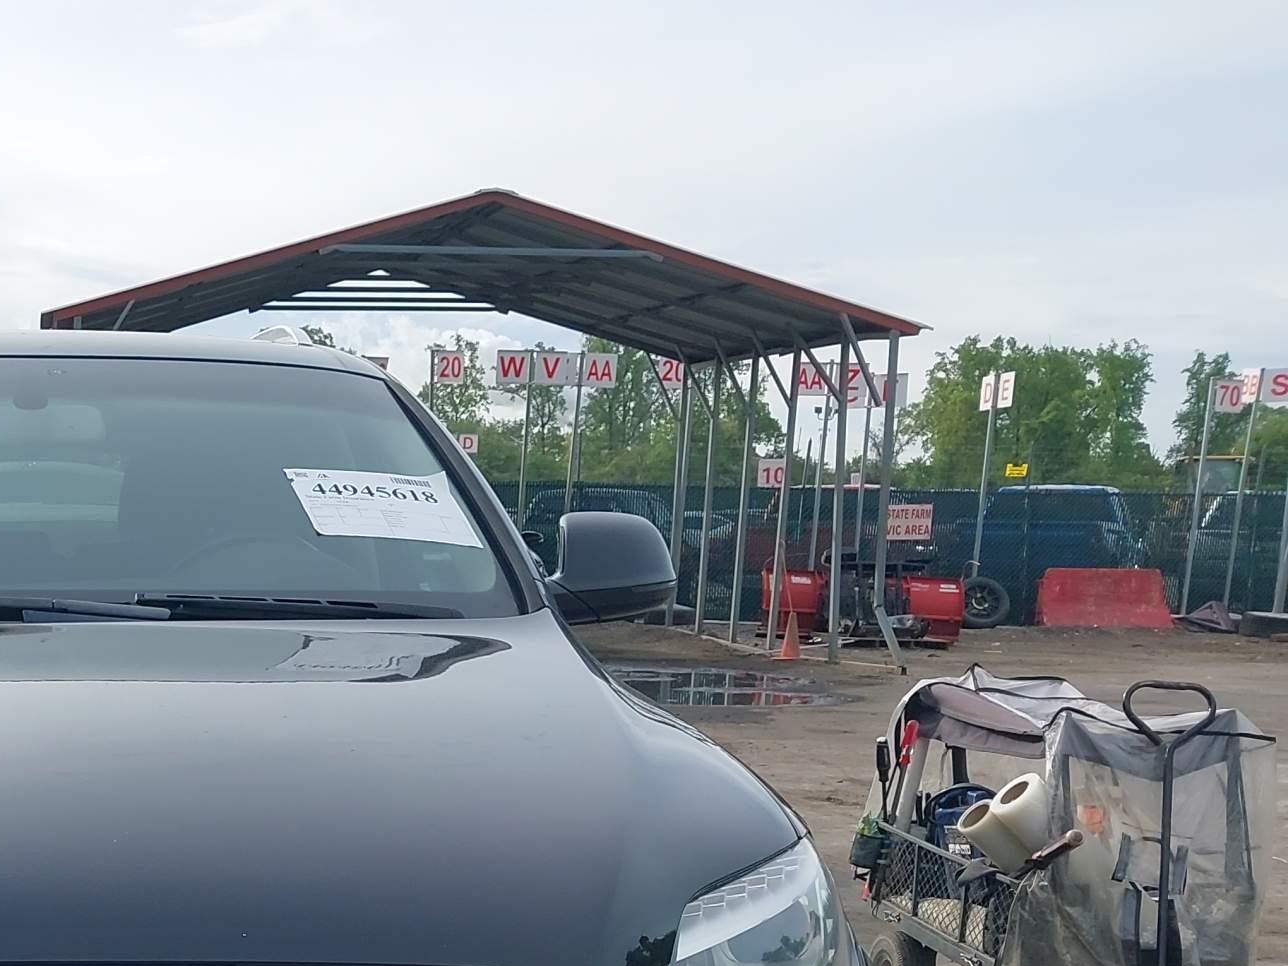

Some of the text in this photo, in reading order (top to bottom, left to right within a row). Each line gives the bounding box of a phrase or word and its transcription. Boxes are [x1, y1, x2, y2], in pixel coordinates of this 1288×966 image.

[439, 356, 462, 378] 20
[500, 356, 526, 378] W
[542, 357, 561, 379] V
[586, 360, 612, 381] AA
[983, 383, 993, 403] D
[1001, 379, 1011, 401] E
[1219, 385, 1241, 407] 70
[463, 437, 474, 450] D
[762, 466, 784, 484] 10
[312, 482, 439, 504] 44945618
[912, 508, 931, 519] FARM
[904, 525, 929, 535] AREA
